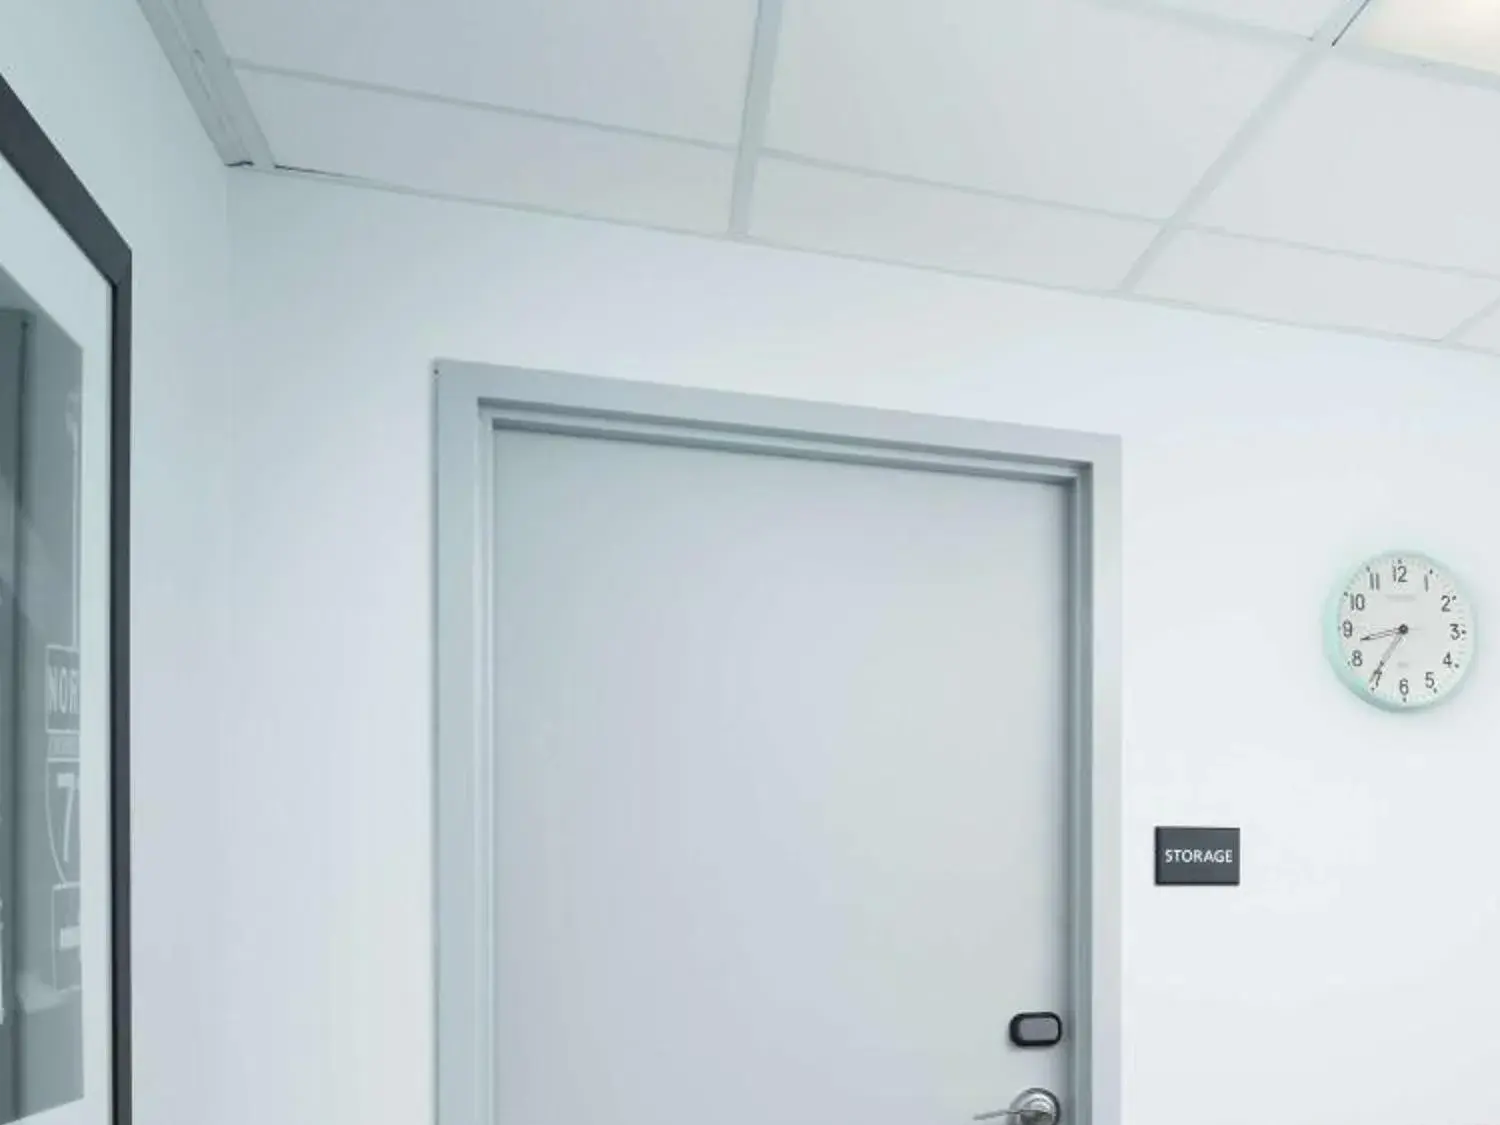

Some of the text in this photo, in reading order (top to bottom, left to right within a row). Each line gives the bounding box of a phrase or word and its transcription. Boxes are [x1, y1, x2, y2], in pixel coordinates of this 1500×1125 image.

[1369, 573, 1380, 590] 11
[1392, 566, 1408, 582] 12
[1350, 593, 1365, 611] 10
[1440, 595, 1452, 612] 2
[1342, 619, 1353, 639] 9
[1450, 623, 1461, 640] 3
[1352, 650, 1363, 667] 8
[1442, 652, 1452, 668] 4
[1399, 678, 1409, 696] 6
[1425, 672, 1435, 689] 5
[56, 772, 80, 863] 7
[1165, 849, 1233, 863] STORAGE
